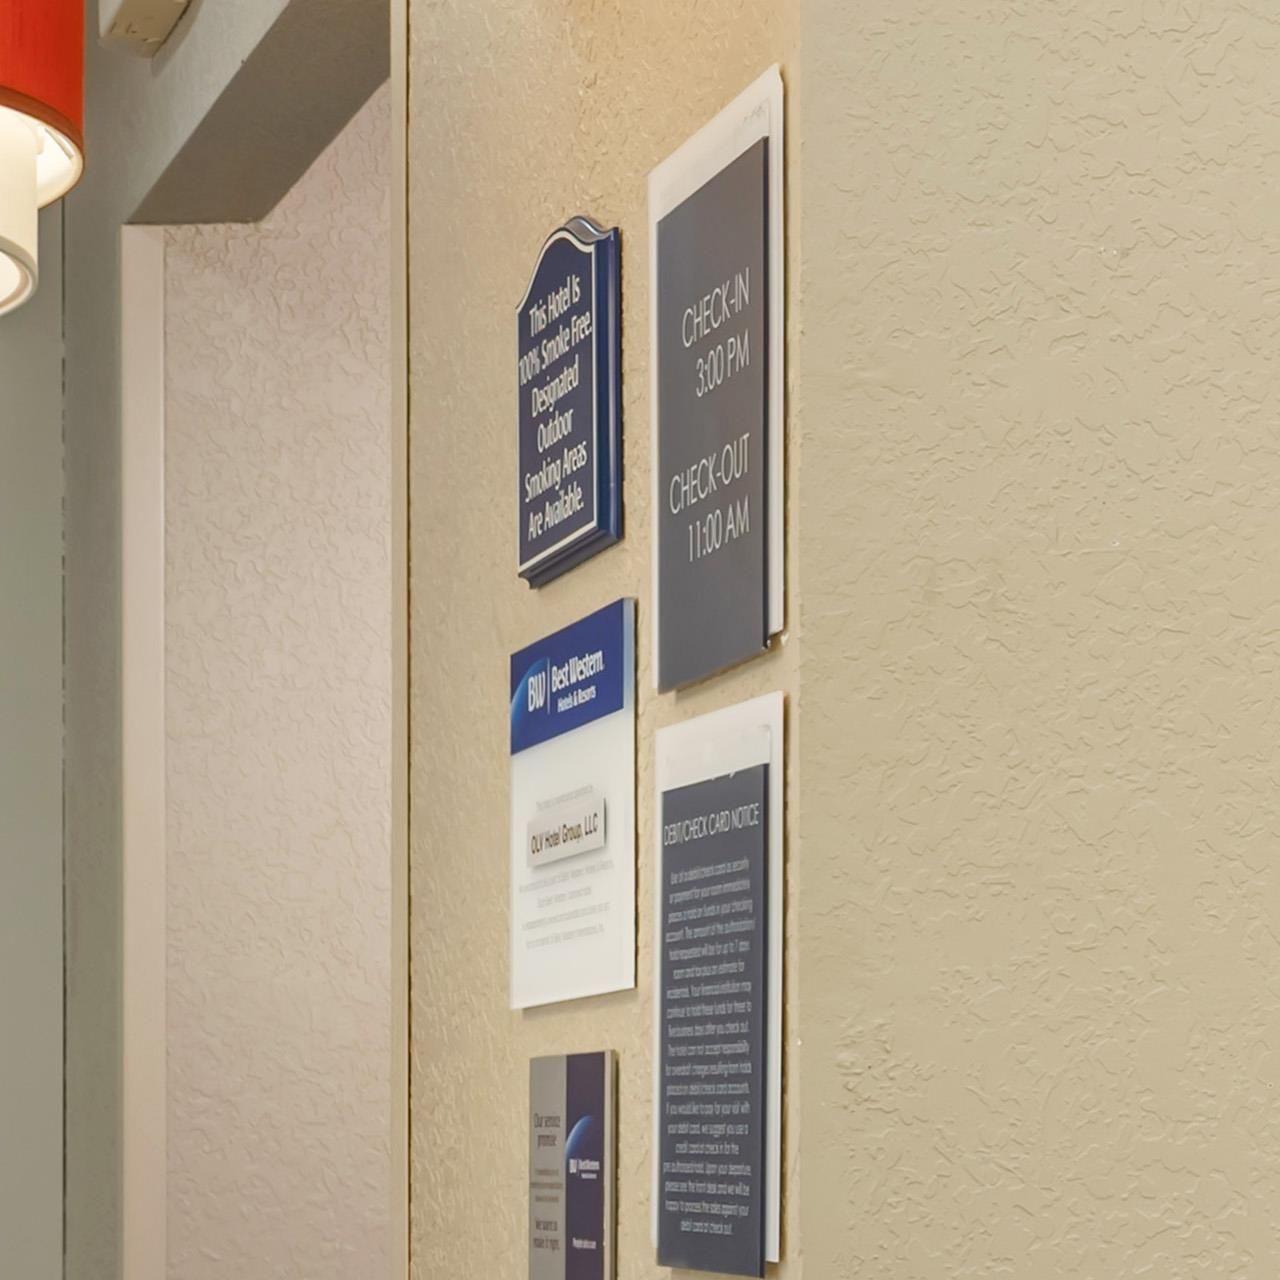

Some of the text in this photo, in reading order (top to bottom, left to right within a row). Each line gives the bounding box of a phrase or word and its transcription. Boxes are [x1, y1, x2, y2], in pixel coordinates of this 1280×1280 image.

[529, 274, 580, 337] This Hotel Is
[682, 266, 750, 347] CHECK-IN
[519, 311, 592, 386] 100% Smoke Free.
[696, 328, 750, 397] 3:00 PM
[532, 353, 579, 417] Designated
[537, 410, 573, 453] Outdoor
[525, 441, 587, 502] Smoking Areas
[669, 432, 750, 514] CHECK-OUT
[528, 481, 584, 541] Are Available.
[688, 495, 750, 562] 11:00 AM
[527, 671, 546, 713] BW
[551, 650, 604, 693] Best Western
[584, 812, 599, 835] LLC
[708, 810, 731, 836] CARD
[731, 803, 760, 831] NOTICE
